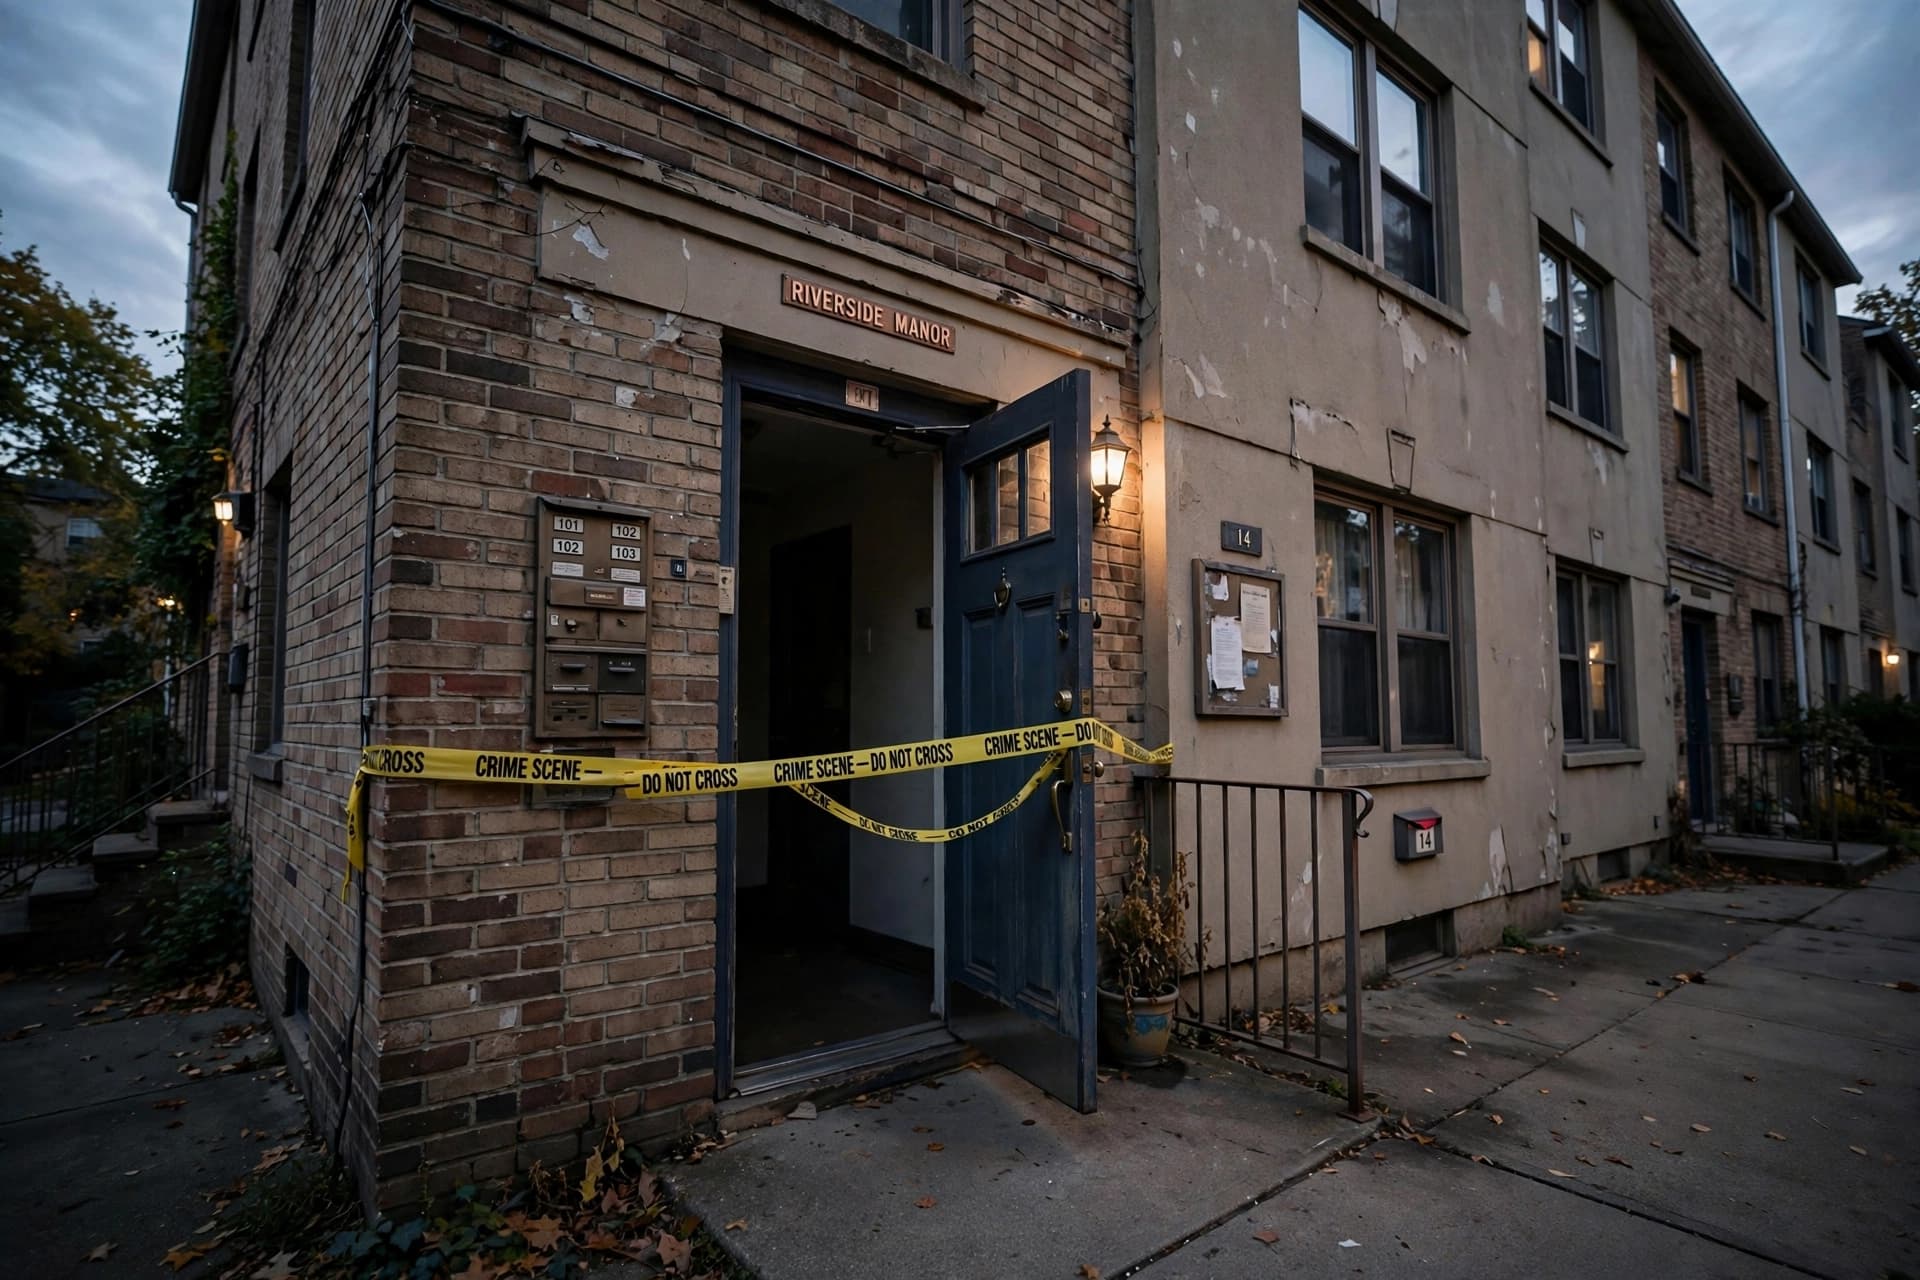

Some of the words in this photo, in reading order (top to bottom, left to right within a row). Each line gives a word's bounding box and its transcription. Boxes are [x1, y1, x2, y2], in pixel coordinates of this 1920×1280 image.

[792, 281, 884, 327] RIVERSIDE
[895, 312, 950, 347] MANOR
[560, 518, 578, 531] 101
[616, 525, 637, 538] 102
[1238, 528, 1251, 548] 14
[558, 540, 579, 553] 102
[616, 547, 636, 559] 103
[379, 749, 425, 773] CROSS
[475, 755, 529, 779] CRIME
[531, 758, 582, 781] SCENE
[642, 773, 662, 794] DO
[665, 770, 692, 793] NOT
[695, 767, 738, 790] CROSS
[774, 759, 814, 783] CRIME
[816, 755, 855, 777] SCENE
[870, 751, 887, 772] DO
[889, 747, 912, 769] NOT
[915, 742, 954, 766] CROSS
[984, 733, 1021, 756] CRIME
[1024, 727, 1060, 749] SCENE
[1075, 721, 1092, 742] DO
[968, 818, 988, 831] NOT
[1420, 831, 1431, 849] 14
